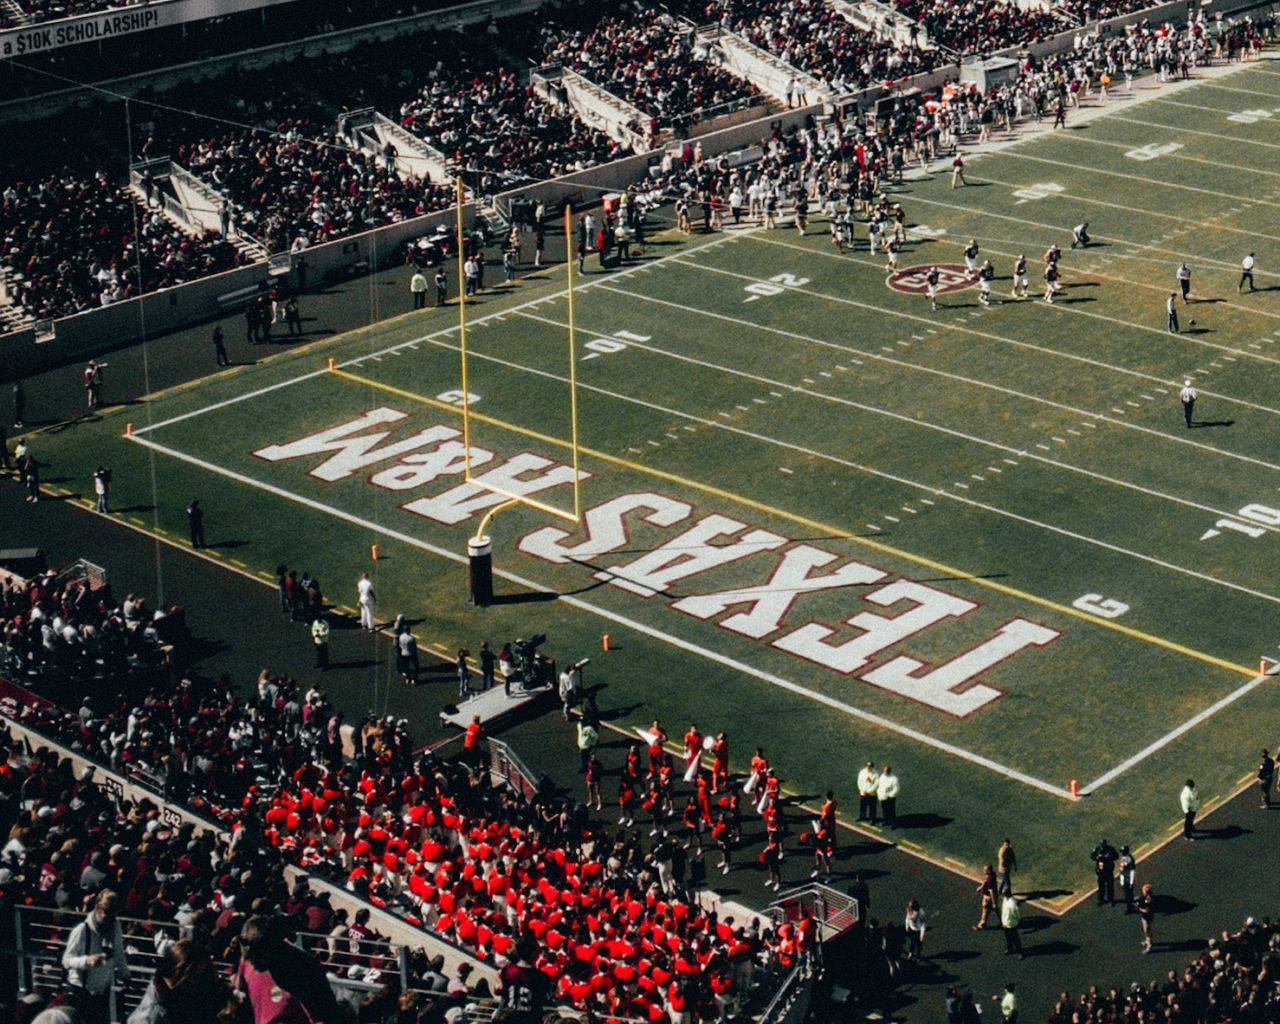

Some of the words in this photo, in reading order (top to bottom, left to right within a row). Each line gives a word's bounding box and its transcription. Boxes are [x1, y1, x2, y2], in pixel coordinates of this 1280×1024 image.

[4, 41, 13, 55] a
[17, 31, 52, 55] $10K
[57, 9, 158, 45] SCHOLARSHIP!
[743, 272, 811, 297] 20
[583, 329, 652, 353] 10
[251, 405, 594, 526] A&M
[516, 490, 1064, 719] TEXAS
[1072, 593, 1131, 619] G
[164, 809, 183, 828] 242
